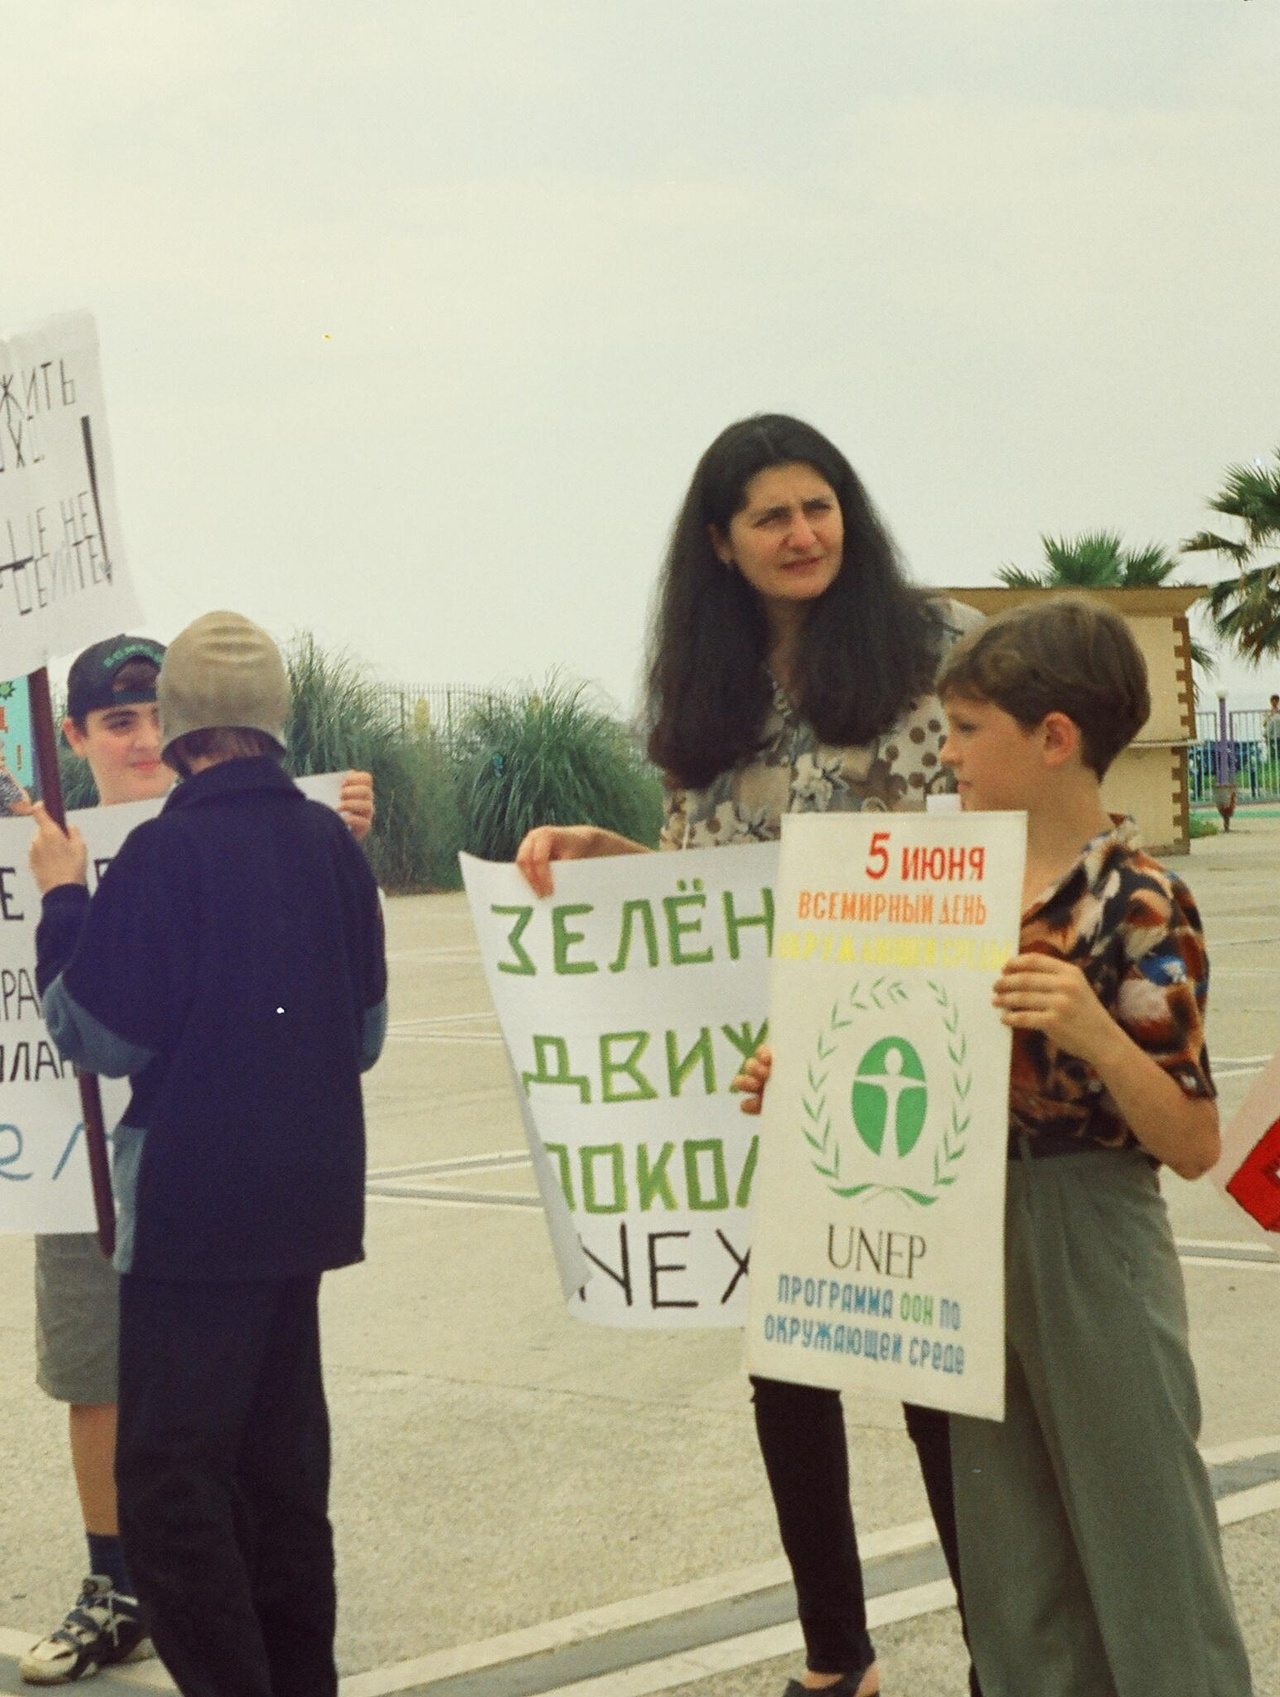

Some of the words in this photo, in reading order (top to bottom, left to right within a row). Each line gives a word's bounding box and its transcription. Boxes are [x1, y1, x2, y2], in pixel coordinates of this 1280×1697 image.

[59, 490, 94, 544] НЕ
[865, 831, 891, 880] 5
[900, 846, 986, 881] ИЮНЯ
[491, 878, 776, 976] ЗЕЛЁН
[798, 889, 934, 924] ВСЕМИРНЫЙ
[939, 894, 987, 925] ДЕНЬ
[827, 1224, 927, 1280] UNEP
[777, 1273, 894, 1319] ПРОГРАММА
[899, 1291, 934, 1326] ООН
[939, 1297, 962, 1331] ПО
